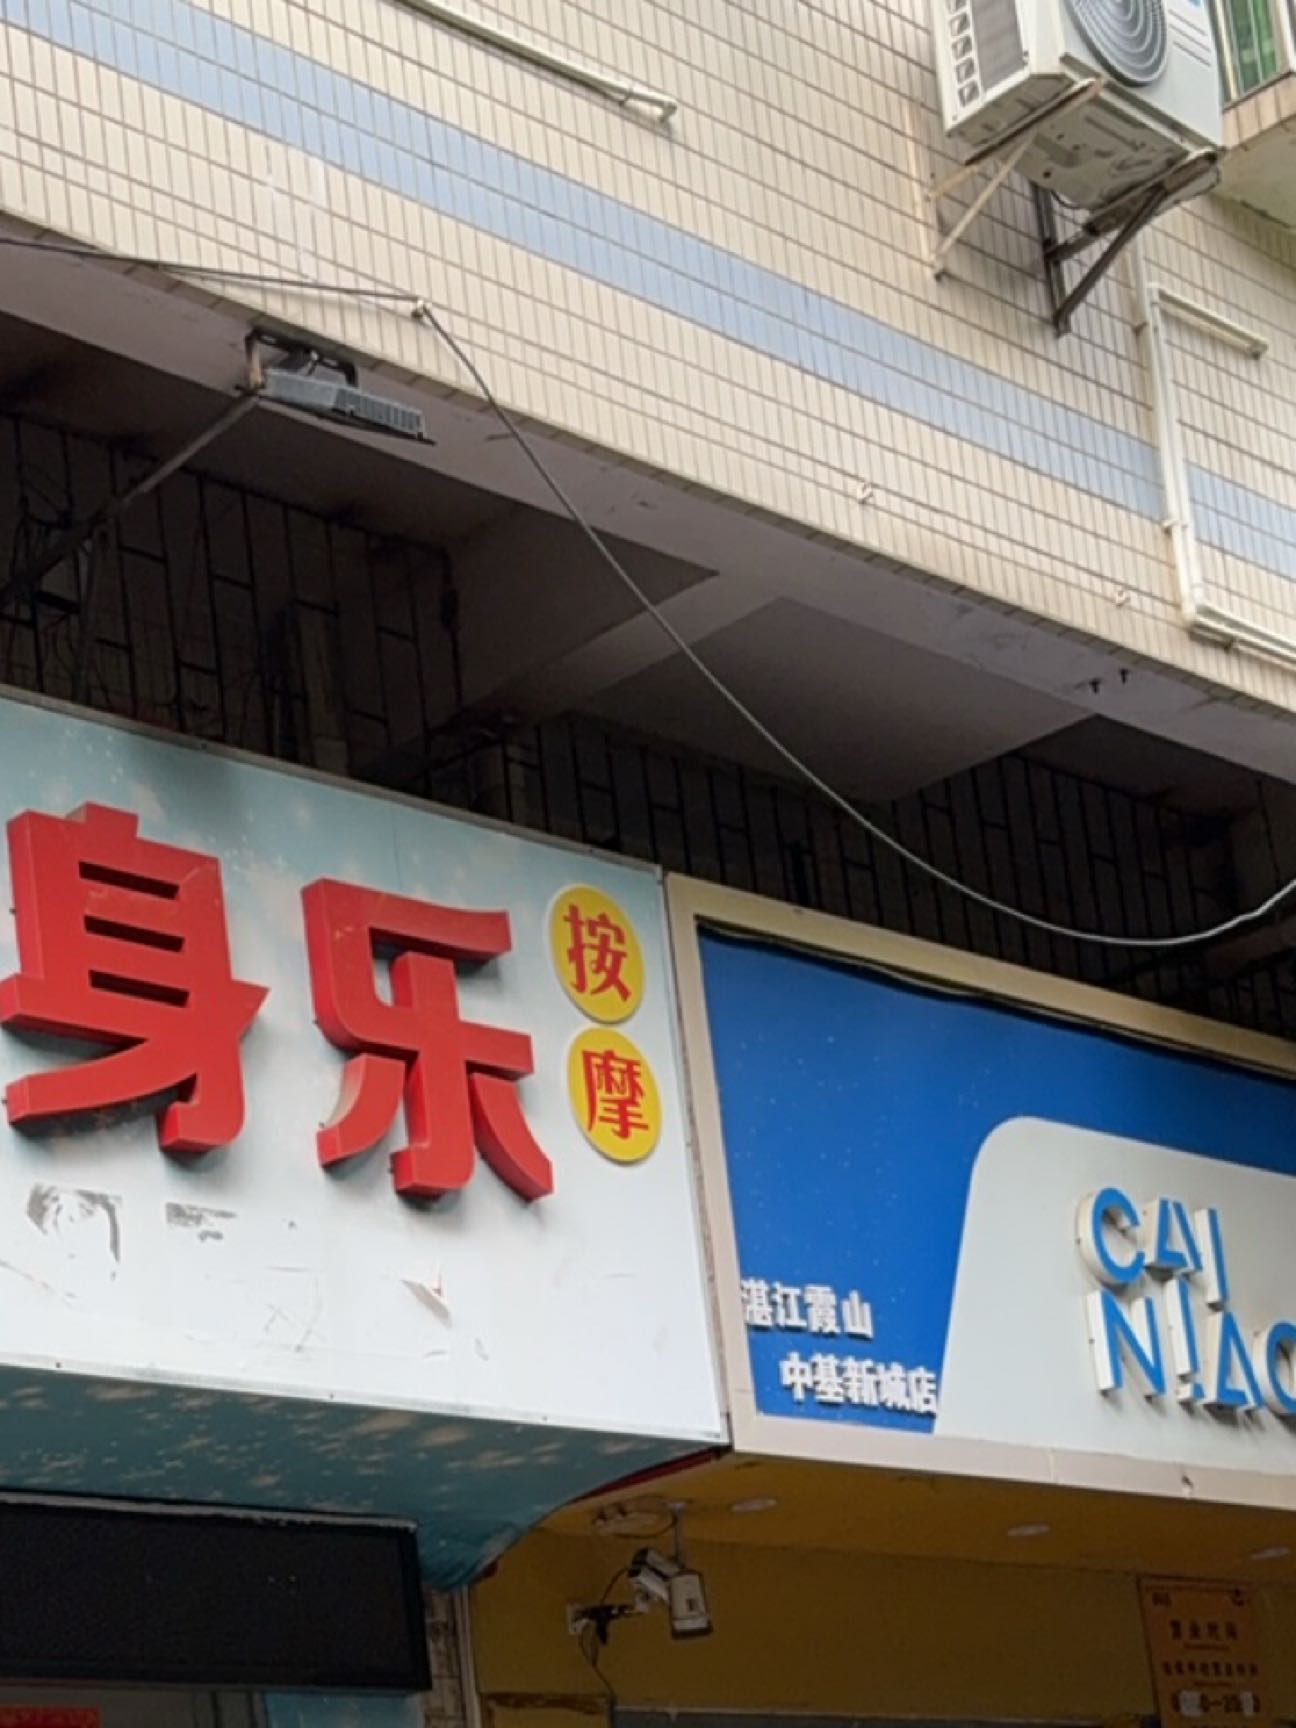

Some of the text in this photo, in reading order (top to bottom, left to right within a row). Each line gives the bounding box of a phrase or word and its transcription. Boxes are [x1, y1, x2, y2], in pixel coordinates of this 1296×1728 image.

[562, 904, 650, 1140] 按摩
[1077, 1186, 1229, 1304] CAI
[740, 1276, 874, 1338] 湛江霞山
